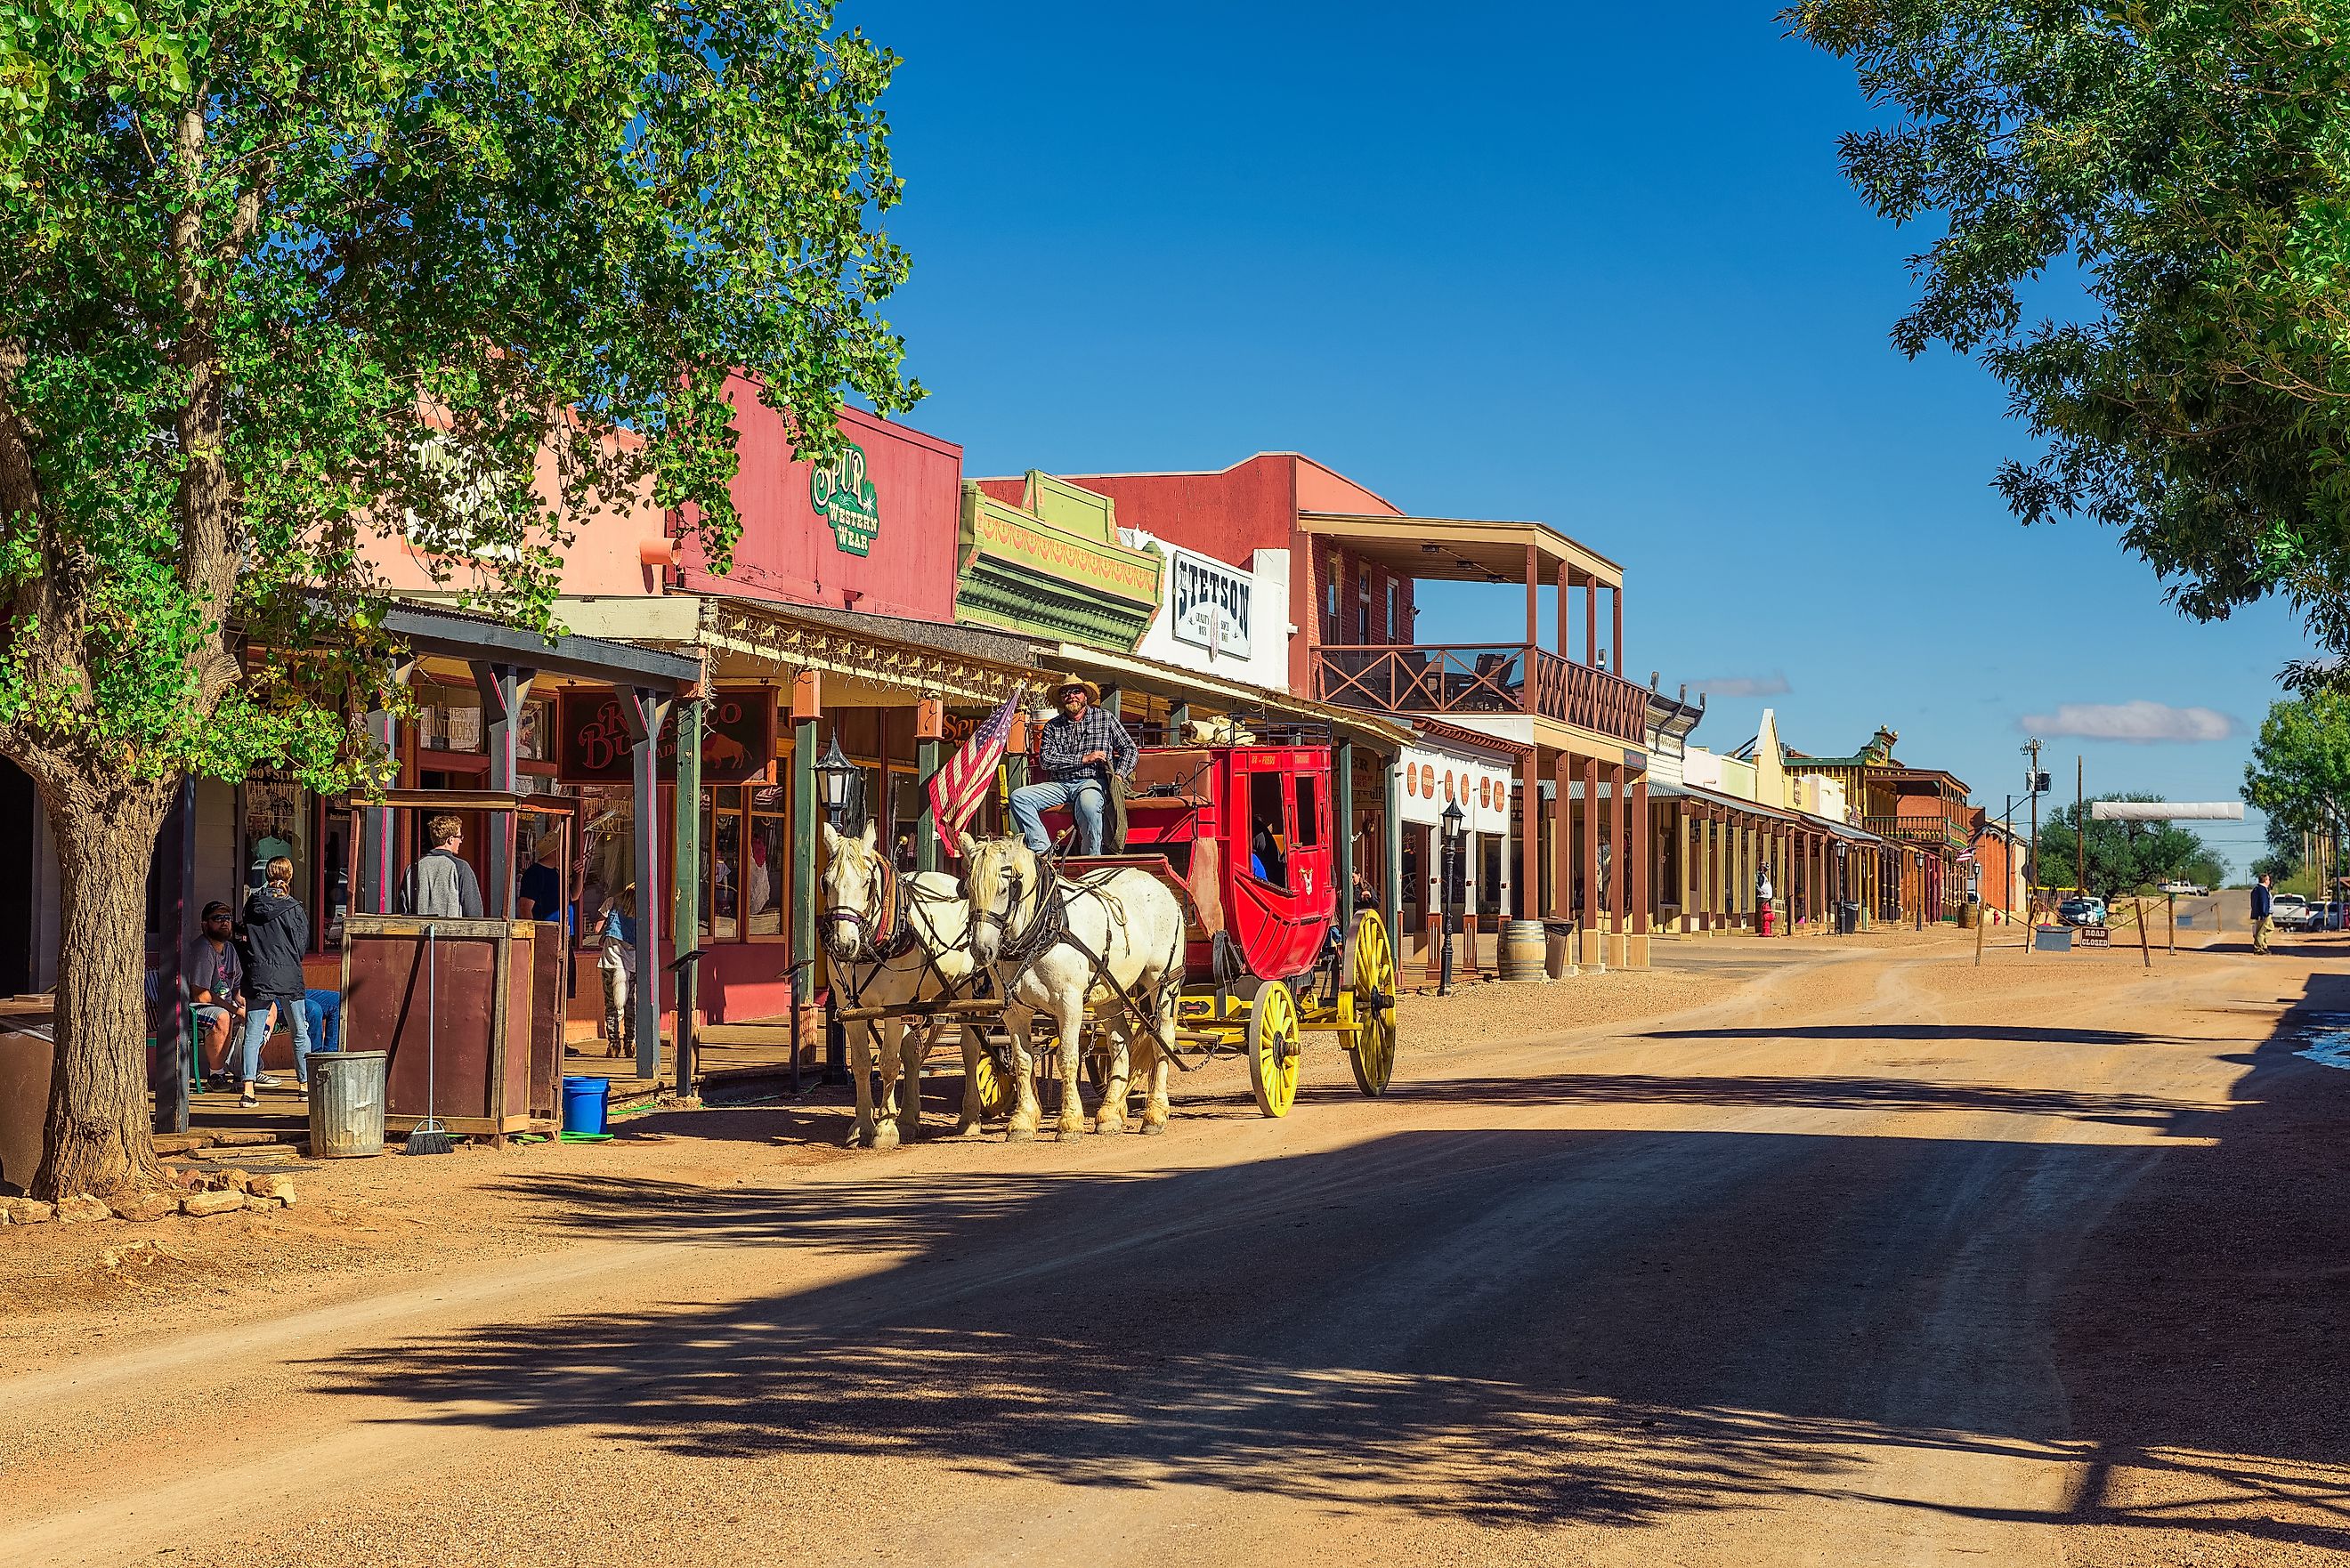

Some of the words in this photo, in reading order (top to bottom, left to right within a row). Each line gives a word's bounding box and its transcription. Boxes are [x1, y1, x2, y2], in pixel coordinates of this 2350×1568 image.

[813, 446, 865, 511] SPUR
[828, 501, 878, 533] WESTERN
[837, 525, 869, 551] WEAR
[1179, 561, 1250, 642] STETSON
[596, 817, 624, 832] ART
